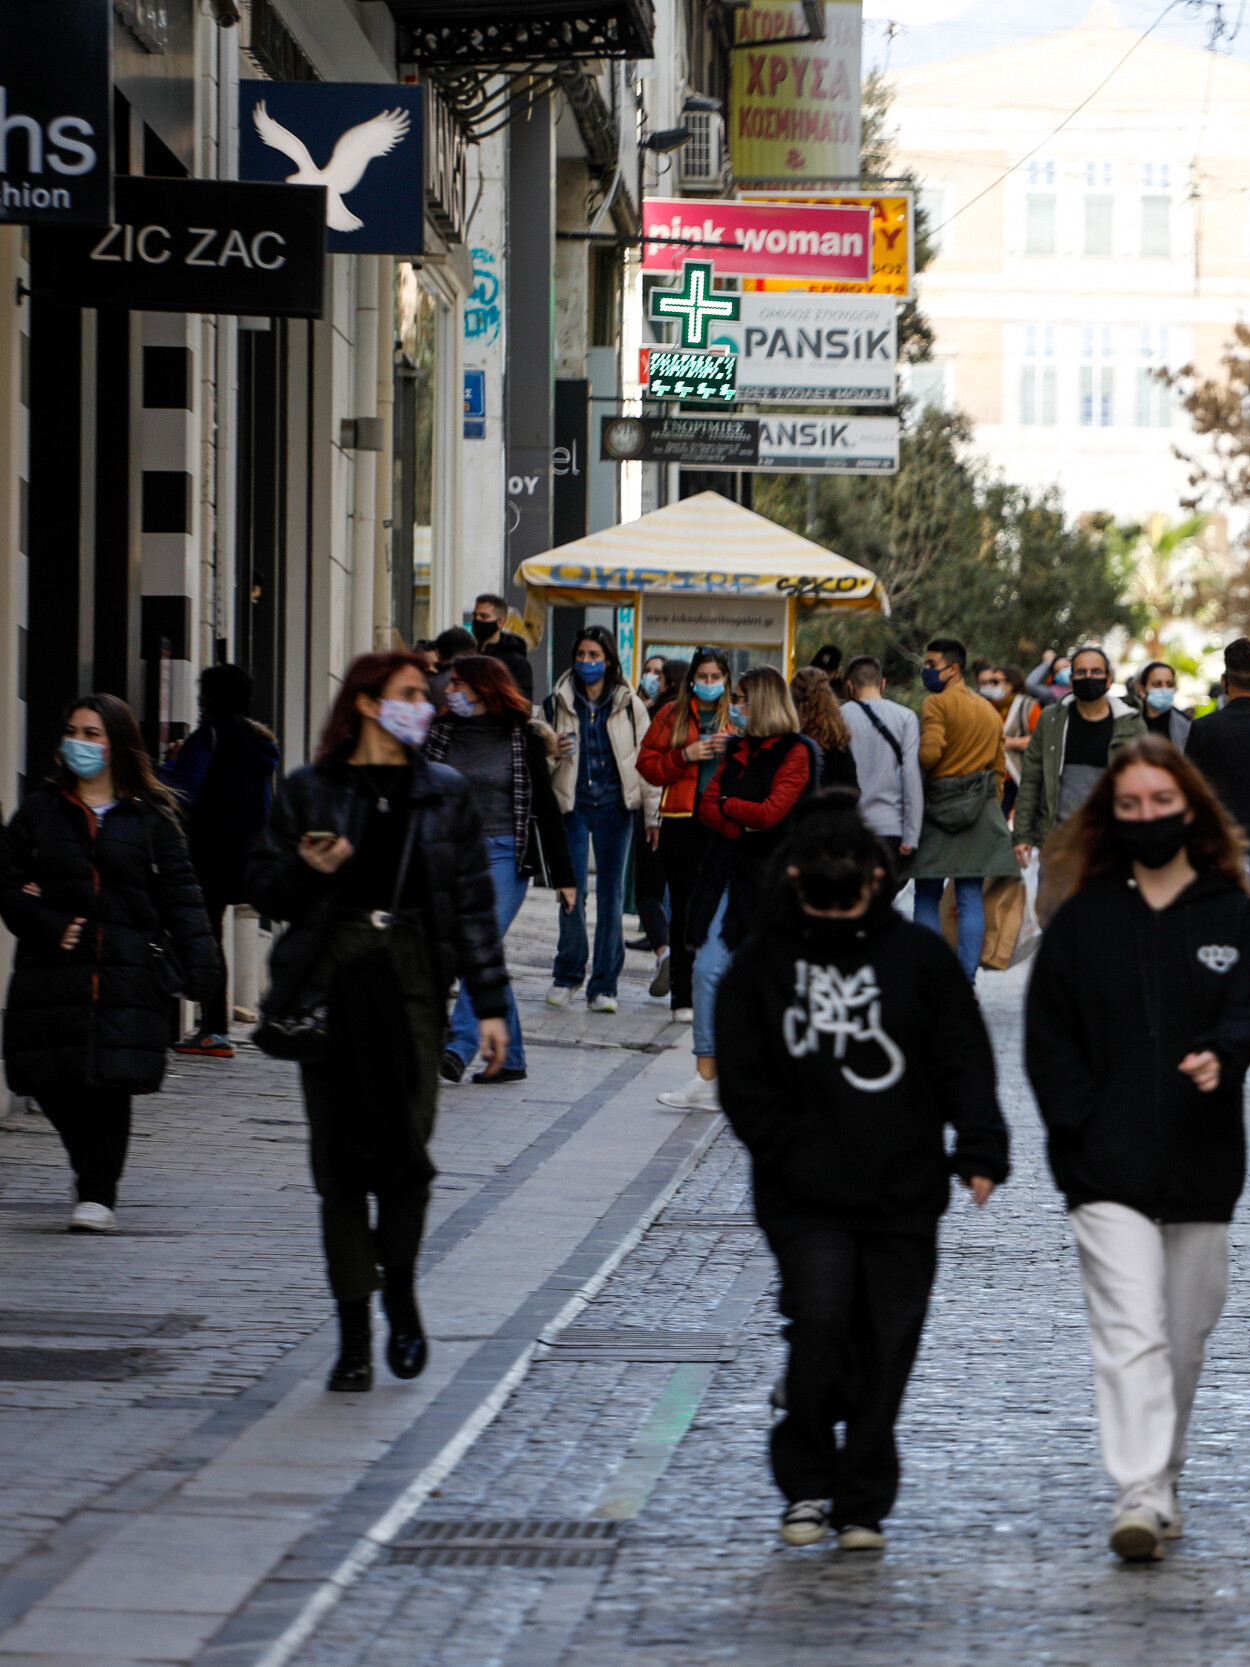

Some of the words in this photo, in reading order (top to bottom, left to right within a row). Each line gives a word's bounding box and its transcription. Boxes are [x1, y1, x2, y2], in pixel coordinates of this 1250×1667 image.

[745, 54, 850, 100] ΧΡΥΣΑ
[739, 105, 854, 143] ΚΟΣΜΗΜΑΤΑ
[0, 181, 71, 209] hion
[90, 225, 171, 264] ZIC
[185, 229, 286, 270] ZAC
[648, 216, 725, 256] pink
[735, 227, 864, 258] woman
